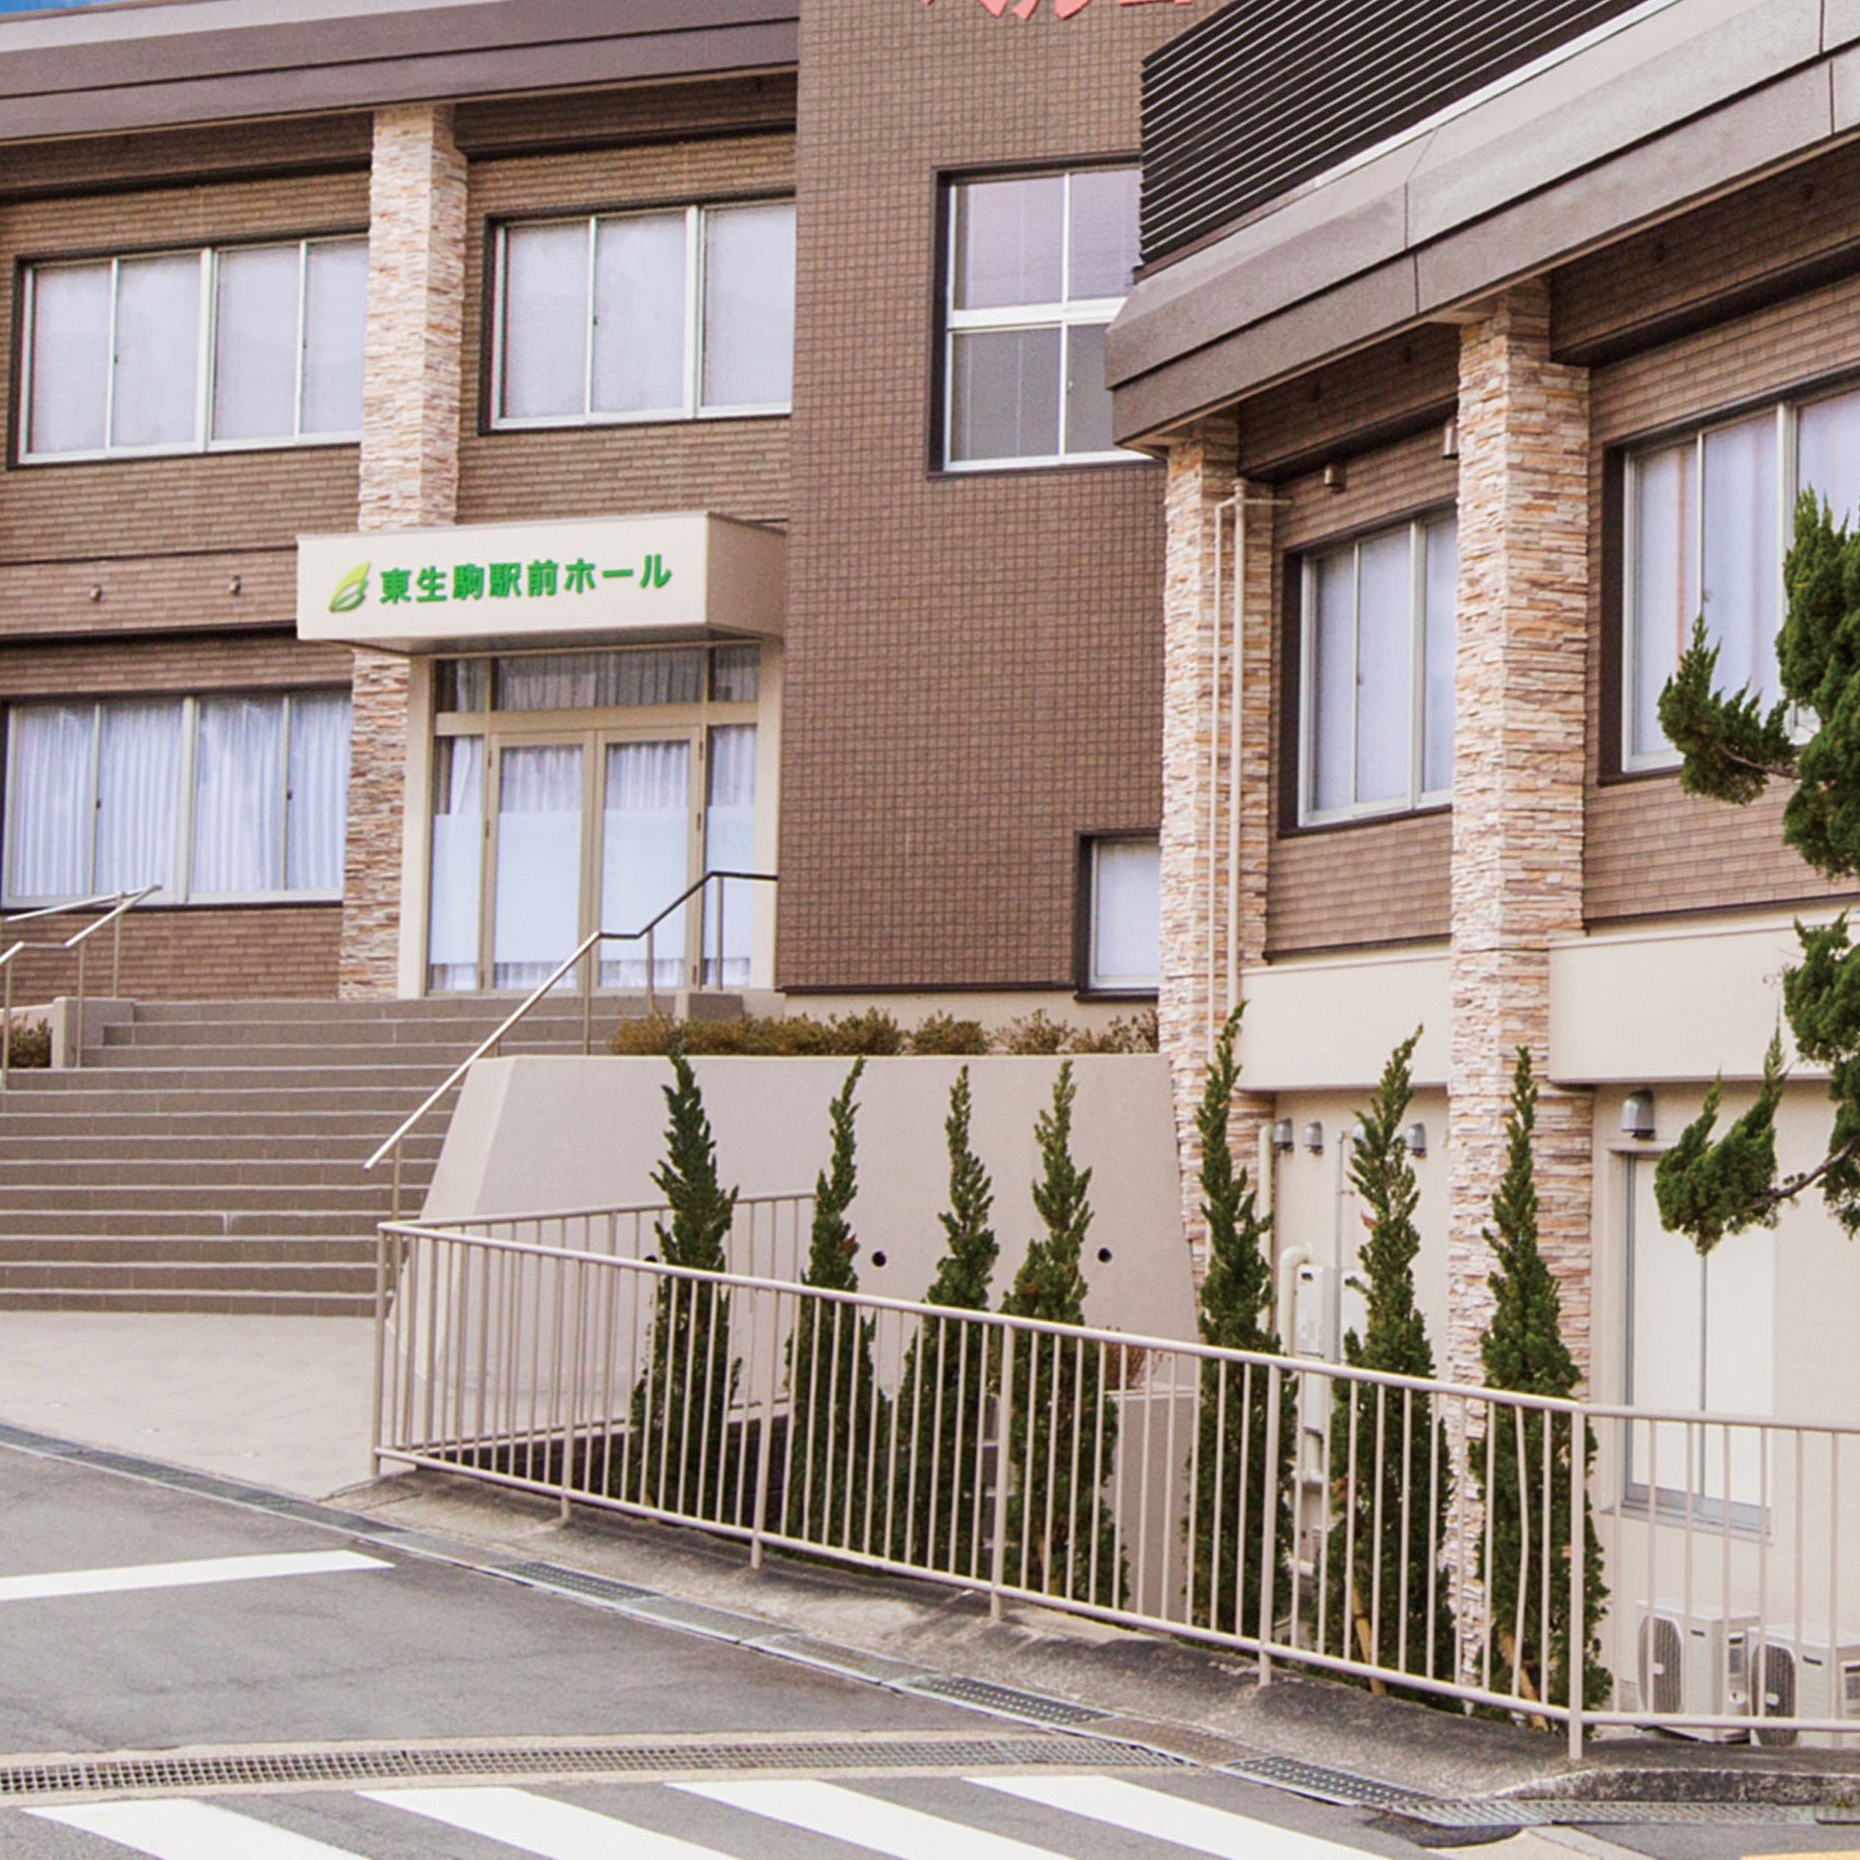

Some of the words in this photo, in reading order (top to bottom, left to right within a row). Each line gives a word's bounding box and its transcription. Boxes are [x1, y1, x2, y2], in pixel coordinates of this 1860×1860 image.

[380, 554, 673, 604] 東生駒駅前ホール
